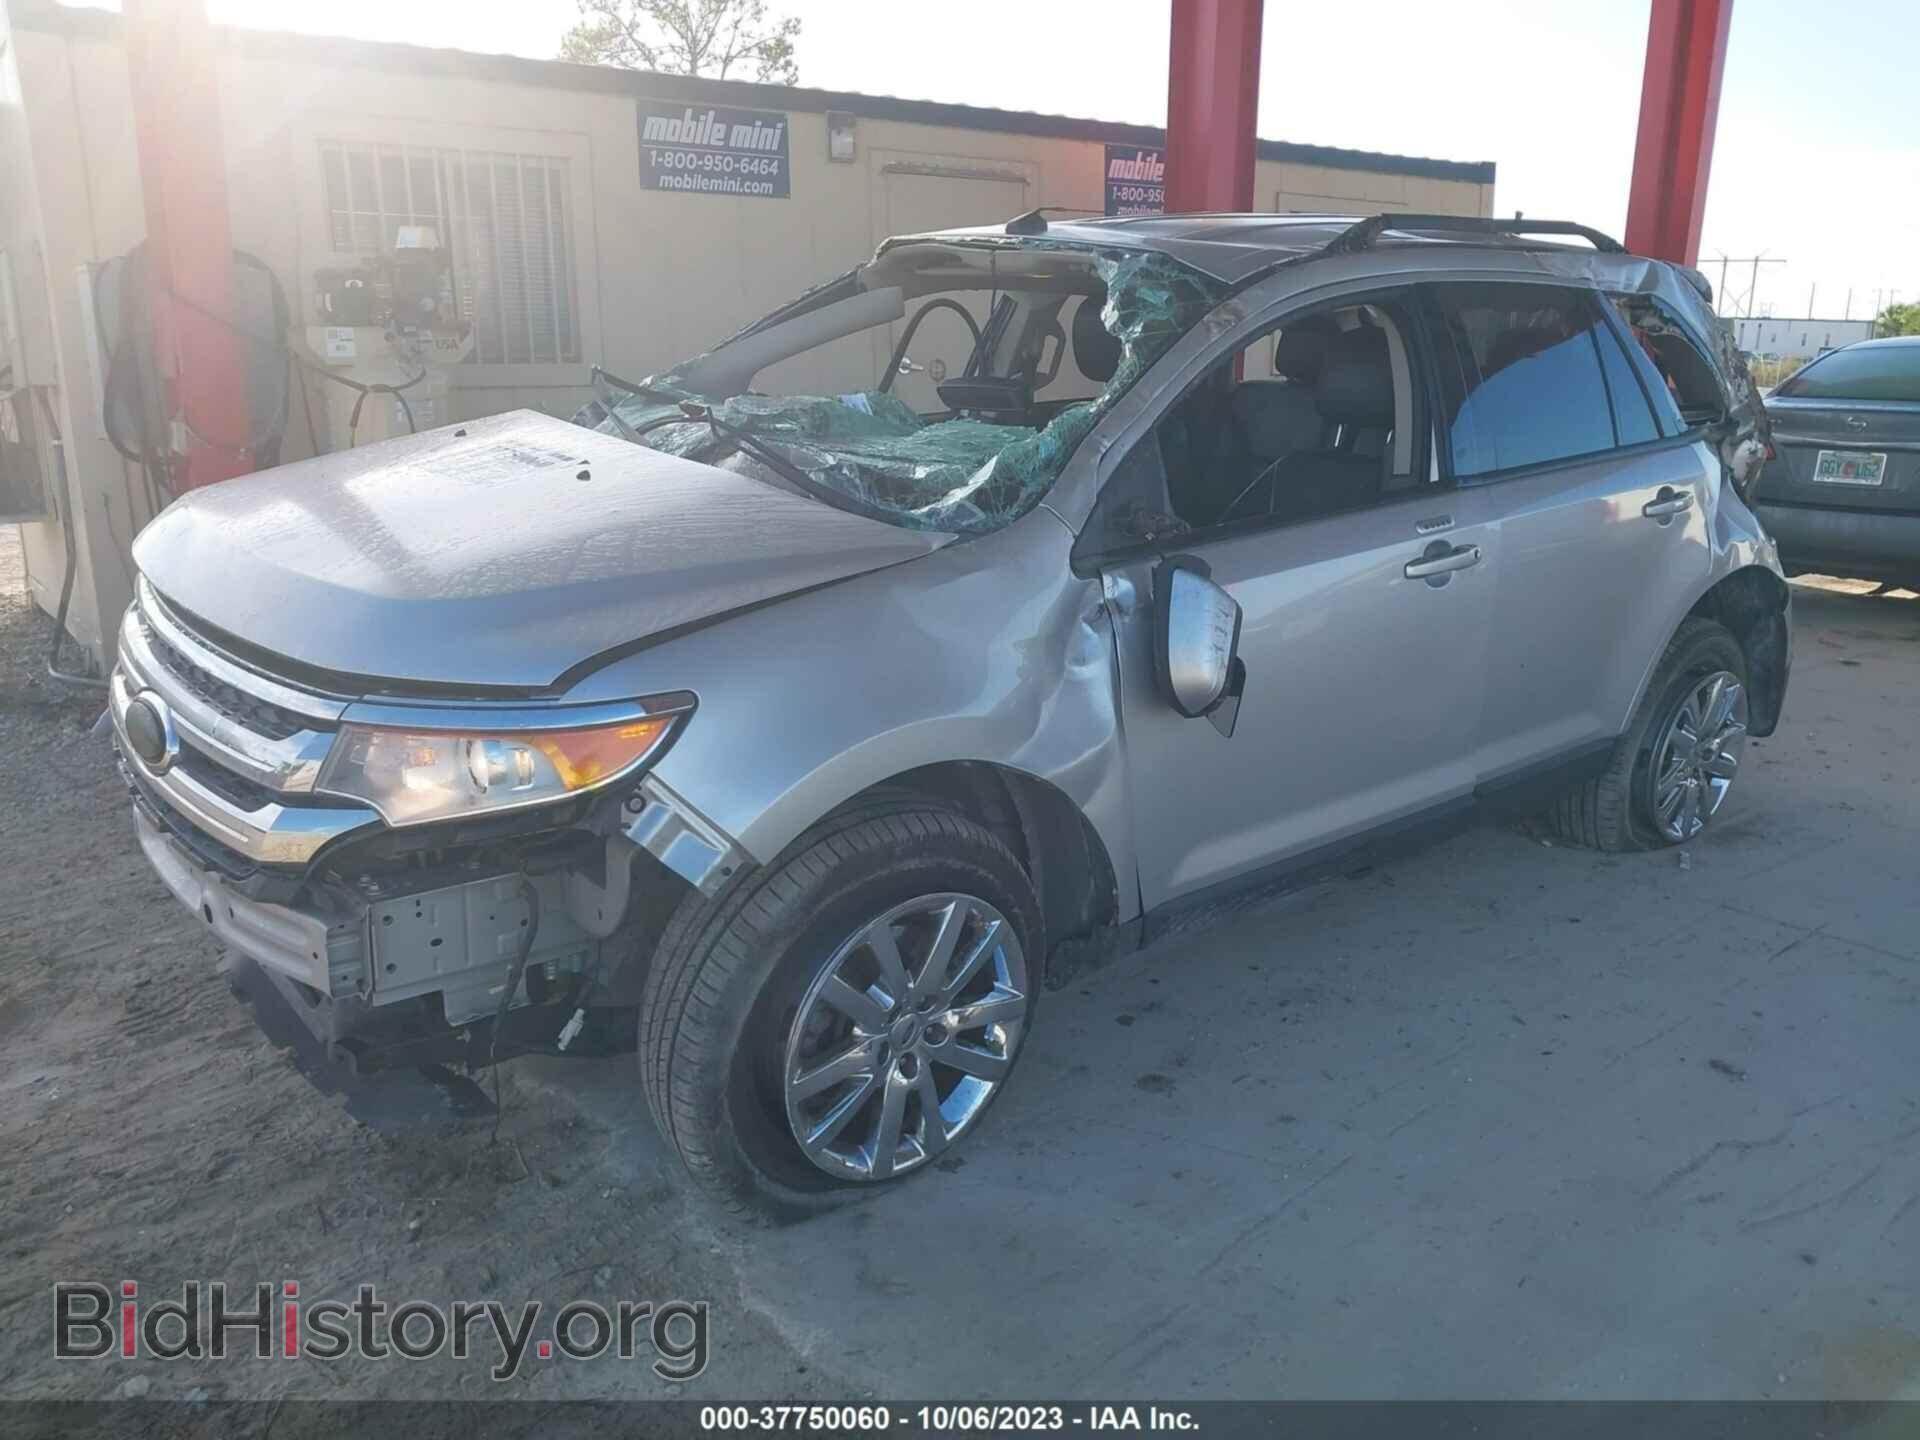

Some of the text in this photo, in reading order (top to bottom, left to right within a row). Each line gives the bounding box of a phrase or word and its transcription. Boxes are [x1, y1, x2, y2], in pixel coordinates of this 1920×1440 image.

[642, 108, 784, 151] mobile mini
[650, 150, 779, 175] 1-800-950-6464
[1108, 152, 1165, 182] mobile
[658, 175, 774, 194] mobilemini.com
